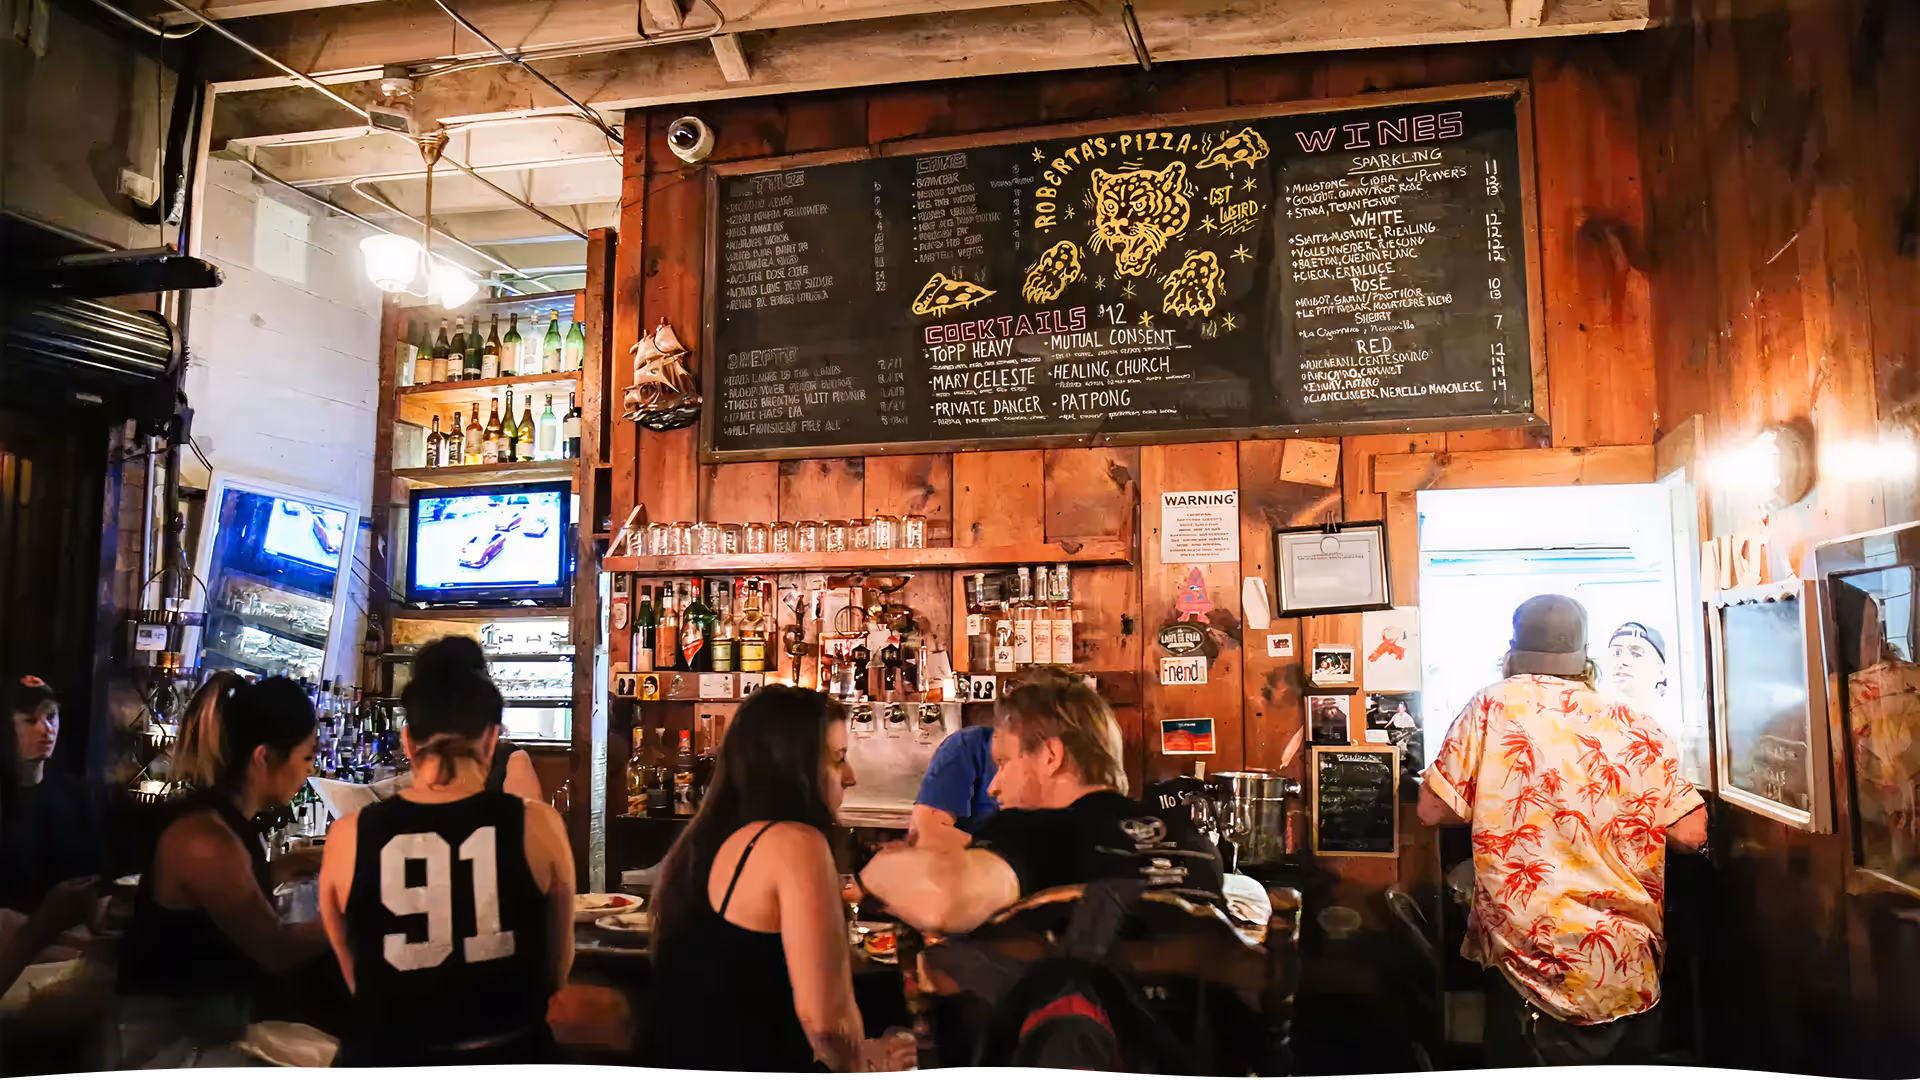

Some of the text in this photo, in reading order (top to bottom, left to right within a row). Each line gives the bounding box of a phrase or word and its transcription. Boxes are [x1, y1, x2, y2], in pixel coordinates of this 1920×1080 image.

[1295, 111, 1463, 153] WINES
[1348, 148, 1442, 171] SPARKLING
[1034, 137, 1108, 228] ROBERTA'S
[1220, 200, 1258, 224] WEIRD
[1350, 209, 1405, 226] WHITE
[1486, 214, 1502, 226] 12
[1487, 226, 1502, 237] 12
[1488, 239, 1505, 250] 12
[1488, 251, 1506, 261] 12
[1488, 277, 1501, 289] 10
[925, 306, 1087, 344] COCKTAILS
[1493, 314, 1502, 329] 7
[1051, 328, 1177, 350] MUTUAL CONSENT
[1356, 336, 1393, 354] RED
[929, 343, 966, 363] TOPP
[972, 338, 1014, 359] HEAVY
[1053, 360, 1110, 379] HEALING
[1116, 356, 1170, 377] CHURCH
[933, 372, 970, 391] MARY
[973, 367, 1036, 389] CELESTE
[1492, 379, 1507, 391] 14
[935, 401, 987, 417] PRIVATE
[993, 395, 1043, 415] DANCER
[1164, 494, 1235, 506] WARNING
[380, 825, 516, 972] 91
